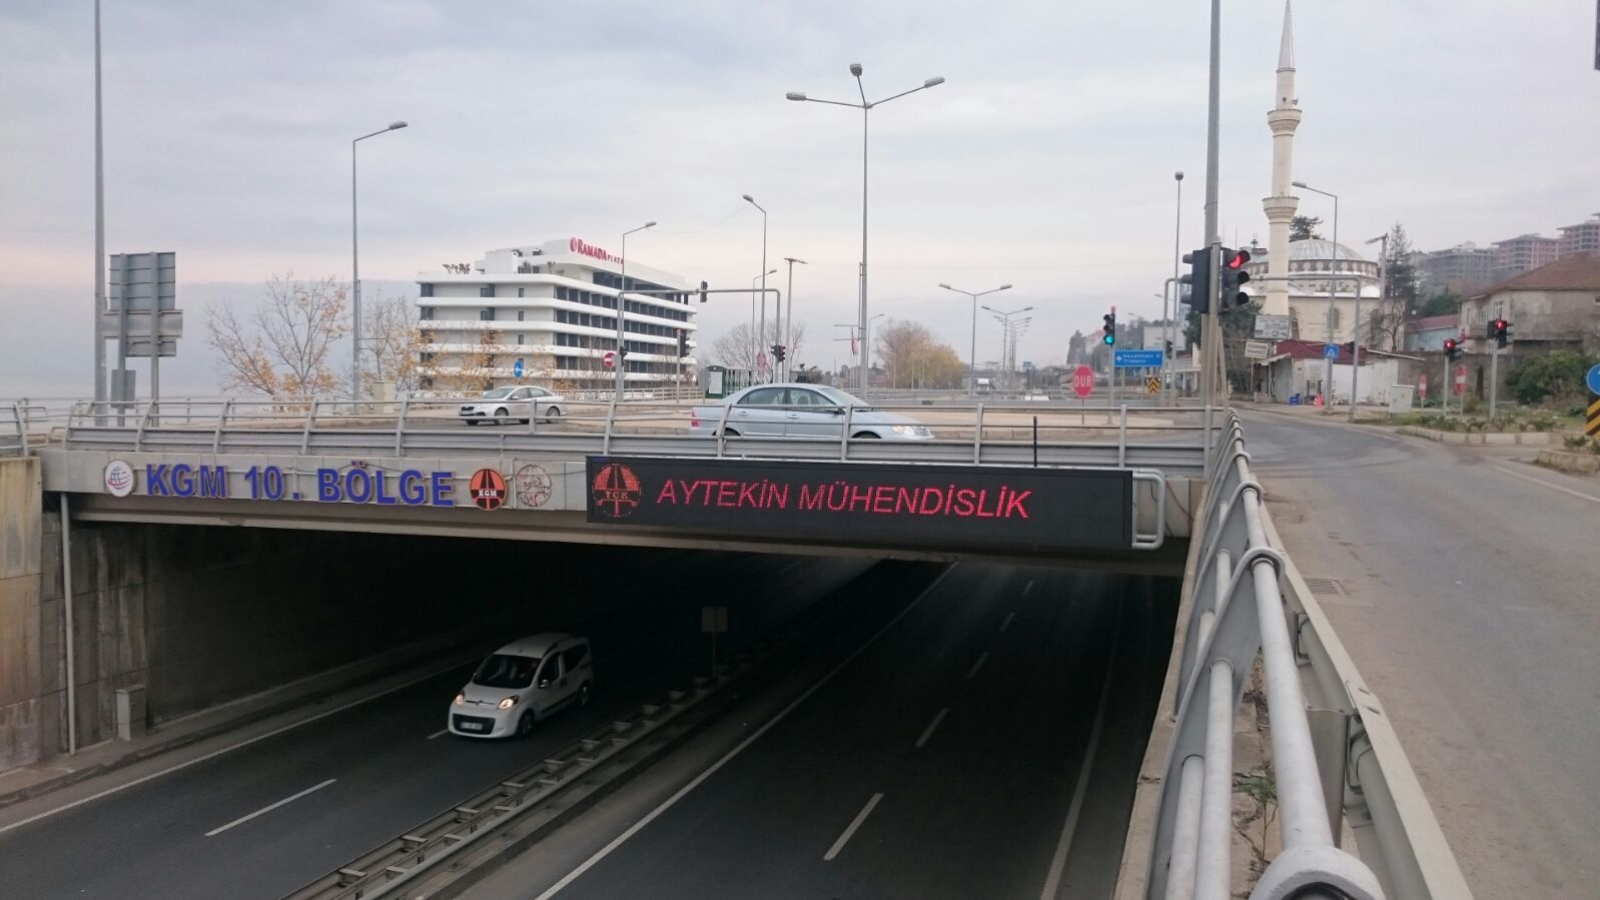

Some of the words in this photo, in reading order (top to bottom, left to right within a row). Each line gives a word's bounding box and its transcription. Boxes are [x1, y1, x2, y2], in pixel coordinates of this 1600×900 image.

[577, 238, 607, 261] RAMADA
[1074, 375, 1092, 388] DUR
[146, 464, 226, 498] KGM
[244, 465, 302, 500] 10.
[317, 460, 454, 507] BÖLGE
[604, 491, 629, 500] TCK
[657, 479, 789, 509] AYTEKİN
[799, 481, 1031, 519] MÜHENDİSLİK
